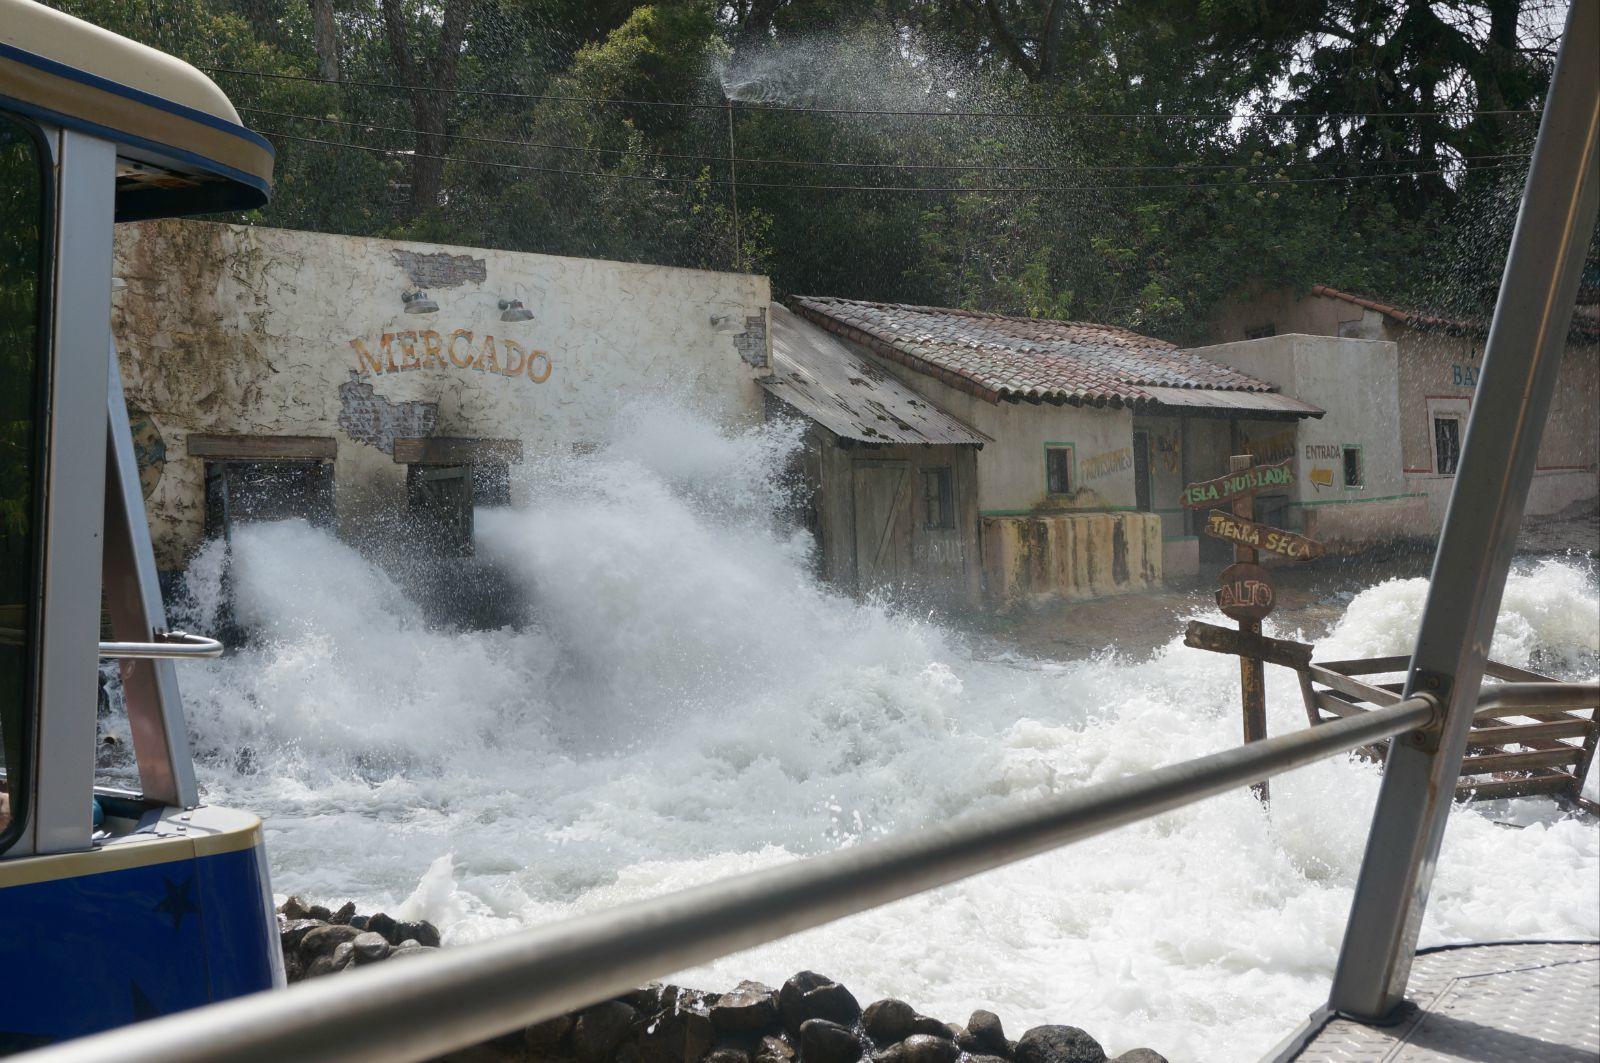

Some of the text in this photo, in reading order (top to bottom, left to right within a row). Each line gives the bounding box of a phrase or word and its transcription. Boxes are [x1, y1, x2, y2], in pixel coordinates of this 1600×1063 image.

[351, 328, 553, 384] MERCADO
[1305, 445, 1341, 459] ENTRADA
[1185, 485, 1220, 504] ISLA
[1210, 517, 1310, 557] TIERRA SECA
[1219, 580, 1272, 607] ALTO
